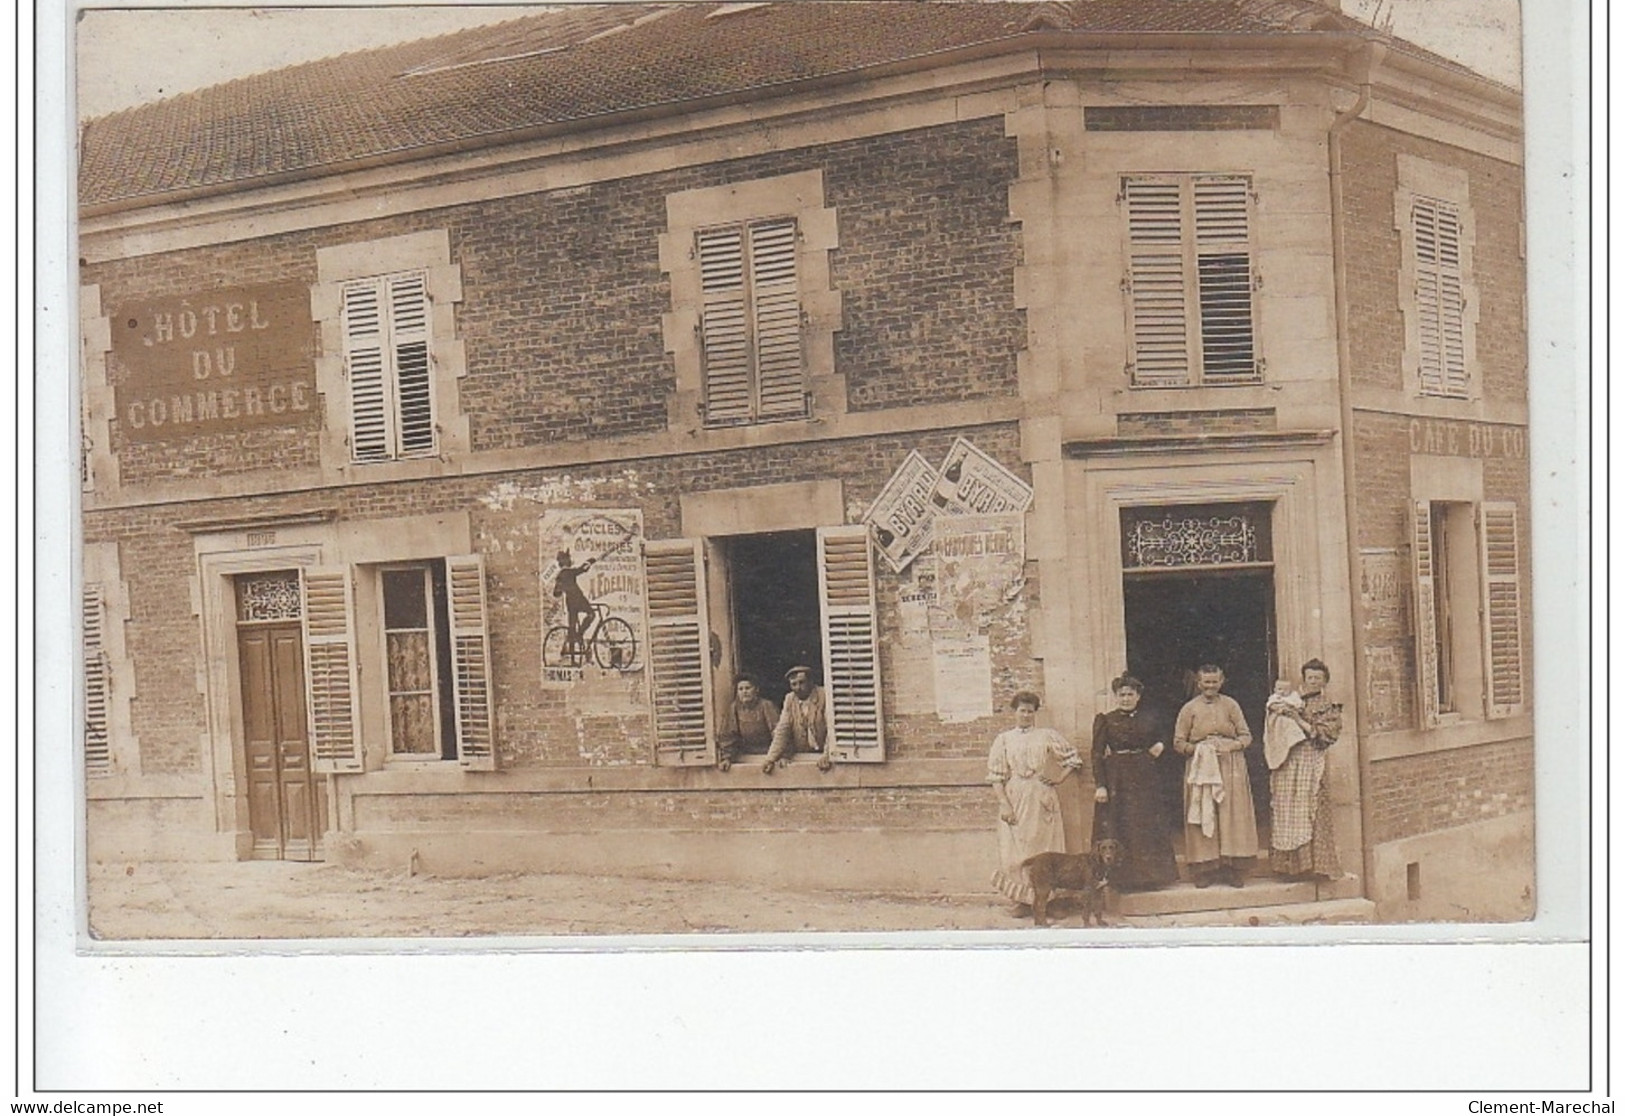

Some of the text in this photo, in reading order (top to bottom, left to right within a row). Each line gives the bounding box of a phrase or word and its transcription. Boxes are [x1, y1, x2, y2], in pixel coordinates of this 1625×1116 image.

[193, 346, 236, 380] DU
[128, 381, 310, 429] COMMERCE
[1469, 424, 1493, 458] DU
